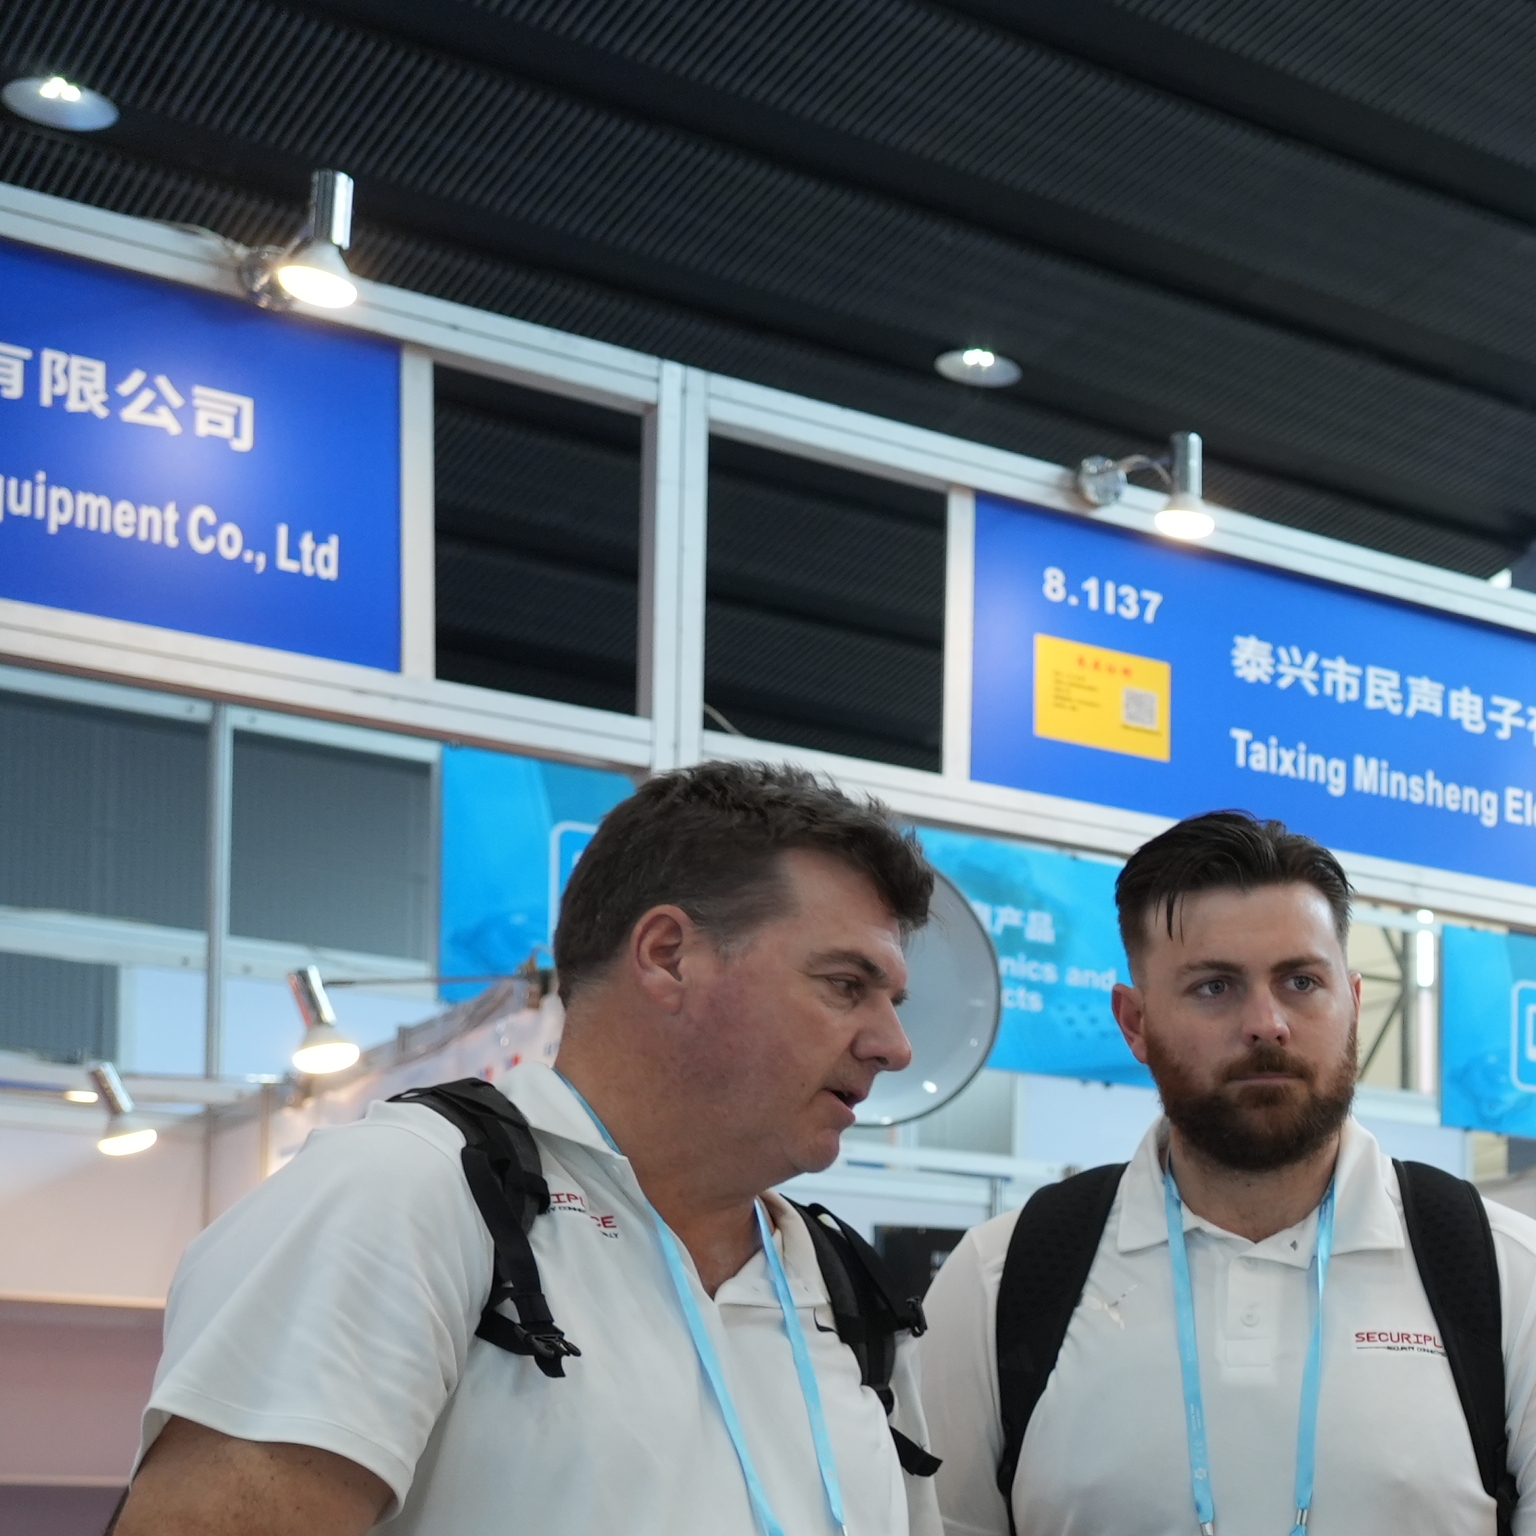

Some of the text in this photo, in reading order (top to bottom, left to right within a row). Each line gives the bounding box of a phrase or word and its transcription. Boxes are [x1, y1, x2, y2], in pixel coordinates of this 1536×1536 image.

[0, 470, 340, 580] uipment Co., Ltd
[1230, 728, 1347, 798] Taixing
[1353, 755, 1498, 827] Minsheng
